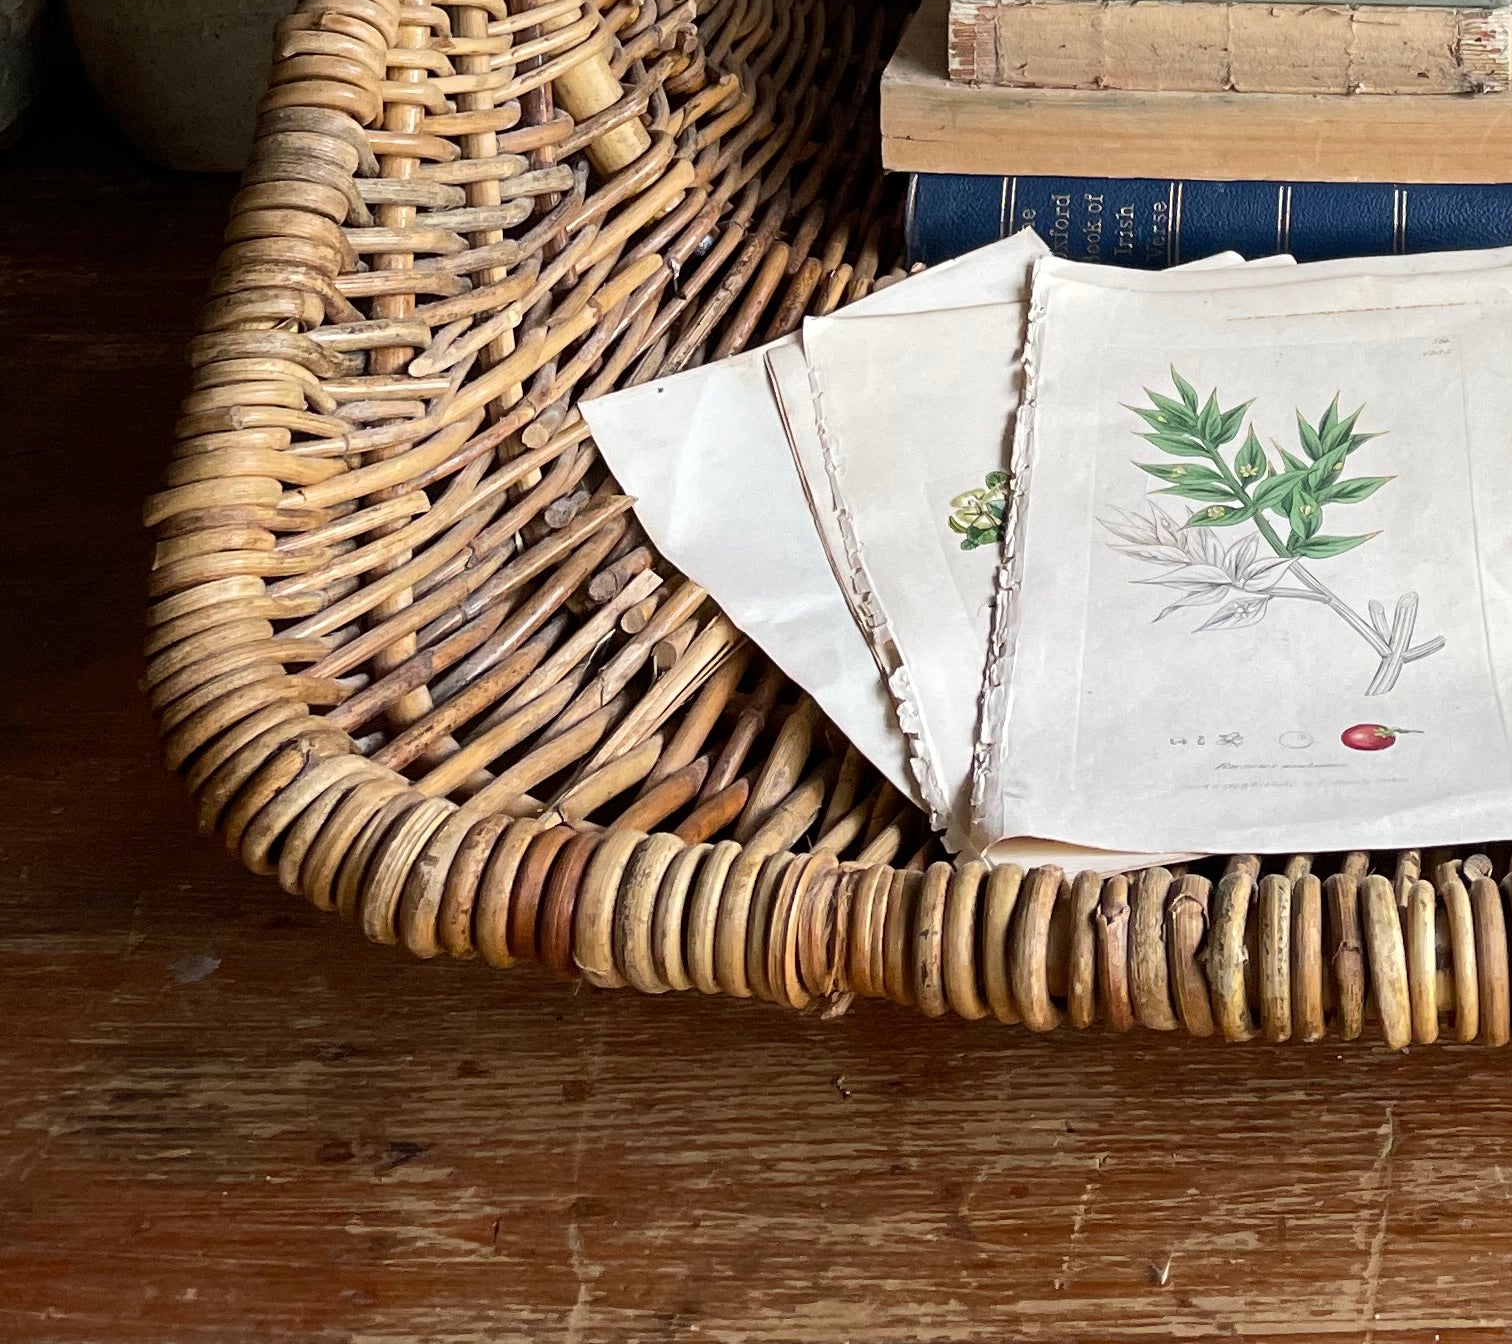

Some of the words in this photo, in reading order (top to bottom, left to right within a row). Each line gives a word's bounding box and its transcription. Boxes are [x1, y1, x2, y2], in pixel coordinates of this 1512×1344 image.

[1084, 193, 1104, 213] of
[1114, 203, 1135, 256] Irish
[1147, 201, 1168, 261] Verse
